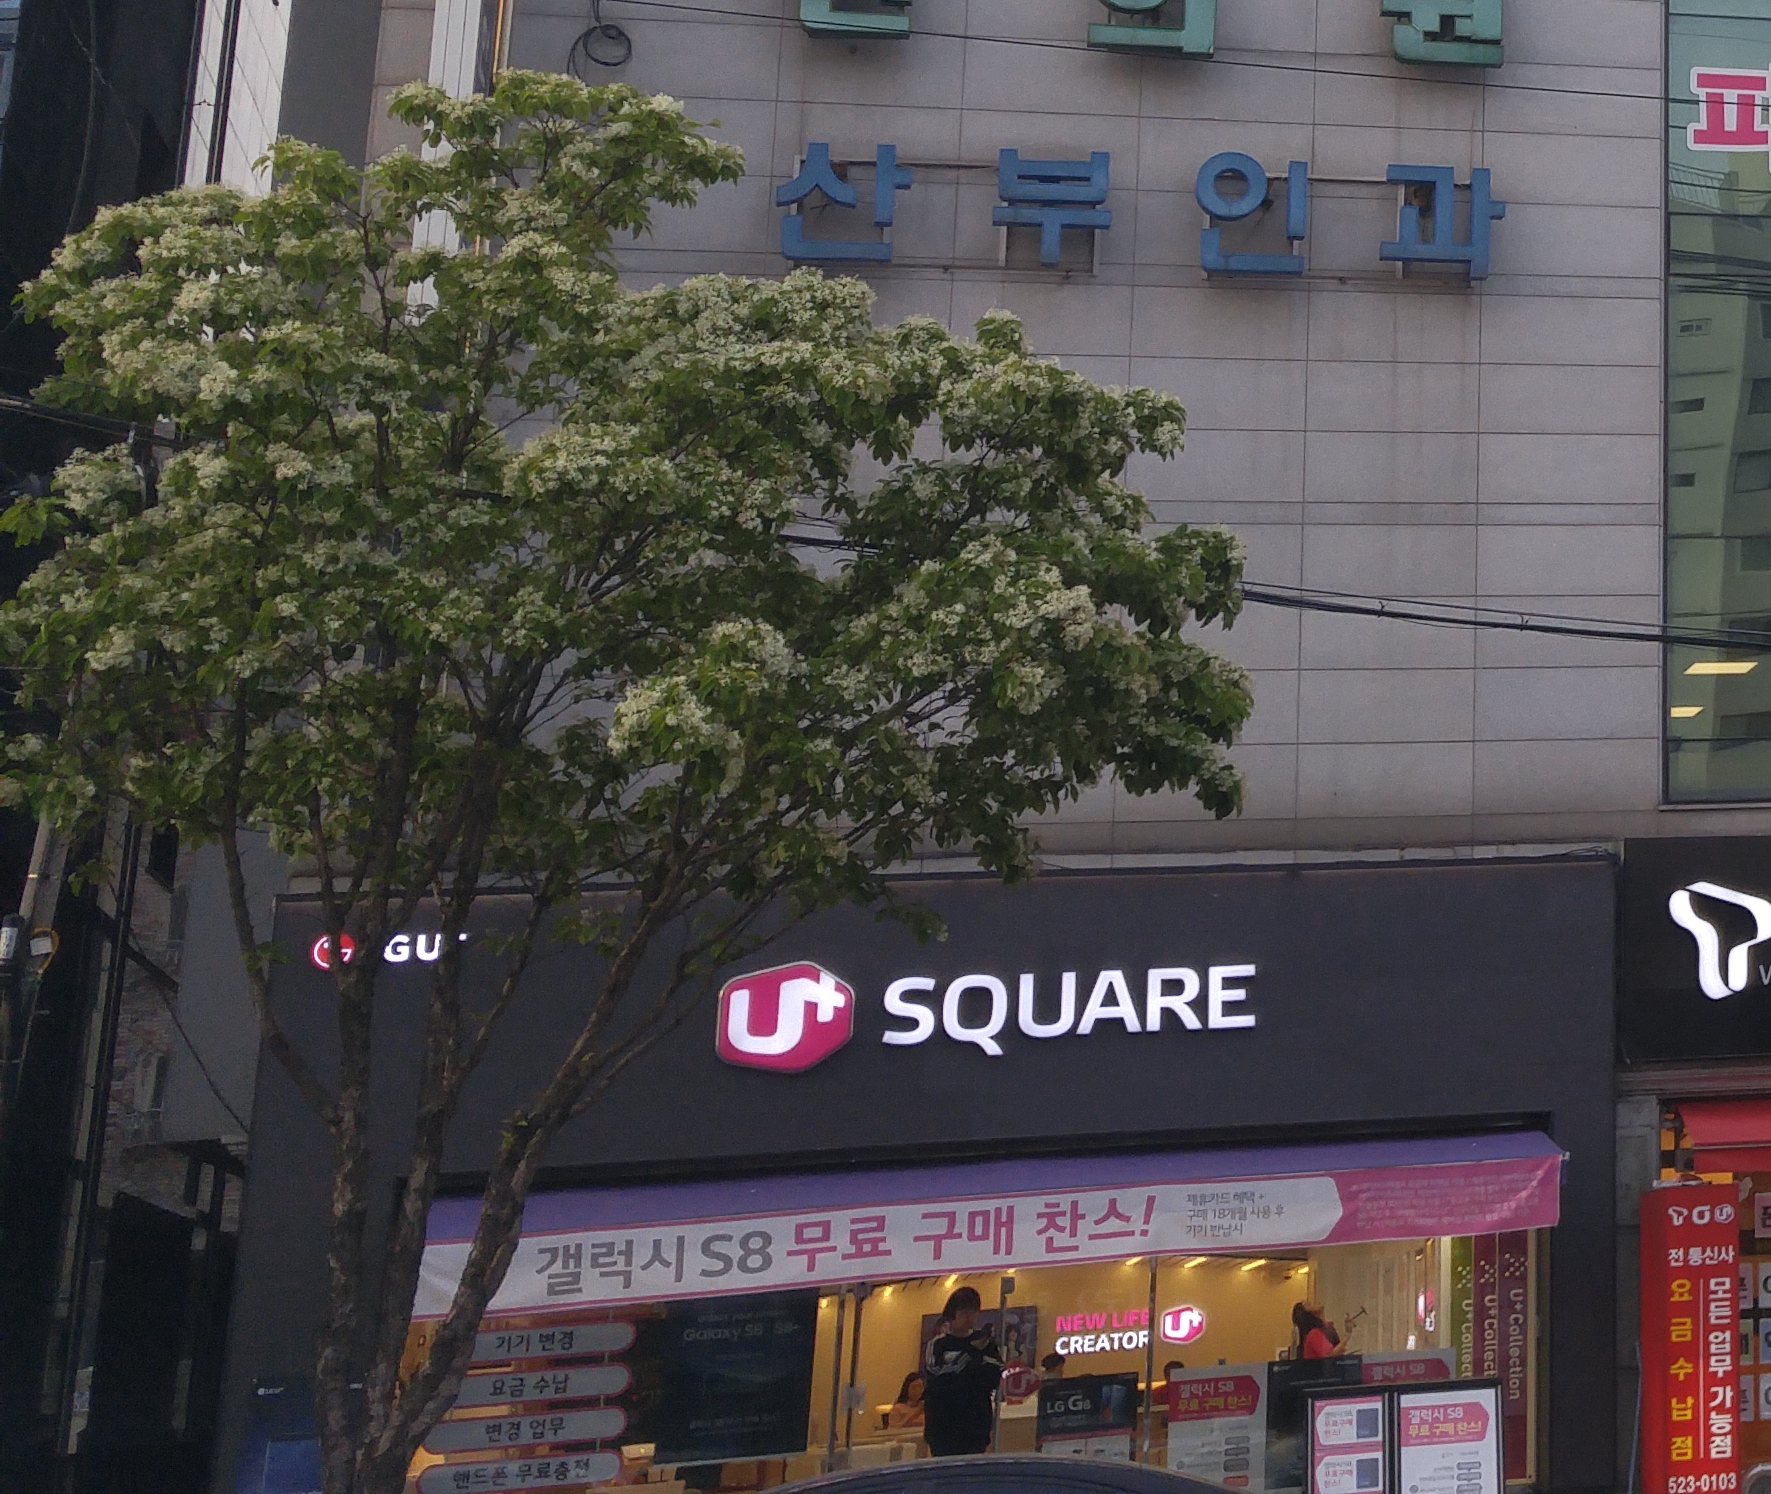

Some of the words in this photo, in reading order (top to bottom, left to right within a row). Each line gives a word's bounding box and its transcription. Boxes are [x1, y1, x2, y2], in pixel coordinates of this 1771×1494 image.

[776, 142, 1505, 281] 산부인과
[881, 964, 1257, 1056] SQUARE
[535, 1233, 689, 1298] 갤럭시
[698, 1230, 774, 1279] S8
[785, 1214, 893, 1274] 무료
[912, 1203, 1016, 1261] 구매
[1035, 1194, 1157, 1256] 찬스!
[1668, 1248, 1685, 1267] 전
[1687, 1245, 1736, 1266] 통신사
[1055, 1311, 1107, 1334] NEW
[1111, 1308, 1150, 1328] LIFE
[494, 1332, 531, 1353] 기기
[537, 1329, 577, 1352] 변경
[1055, 1329, 1150, 1356] CREATOR
[1669, 1278, 1695, 1462] 요금수납점
[488, 1377, 527, 1398] 요금
[531, 1374, 571, 1397] 수납
[528, 1416, 567, 1439] 업무
[1667, 1472, 1738, 1494] 523-0103
